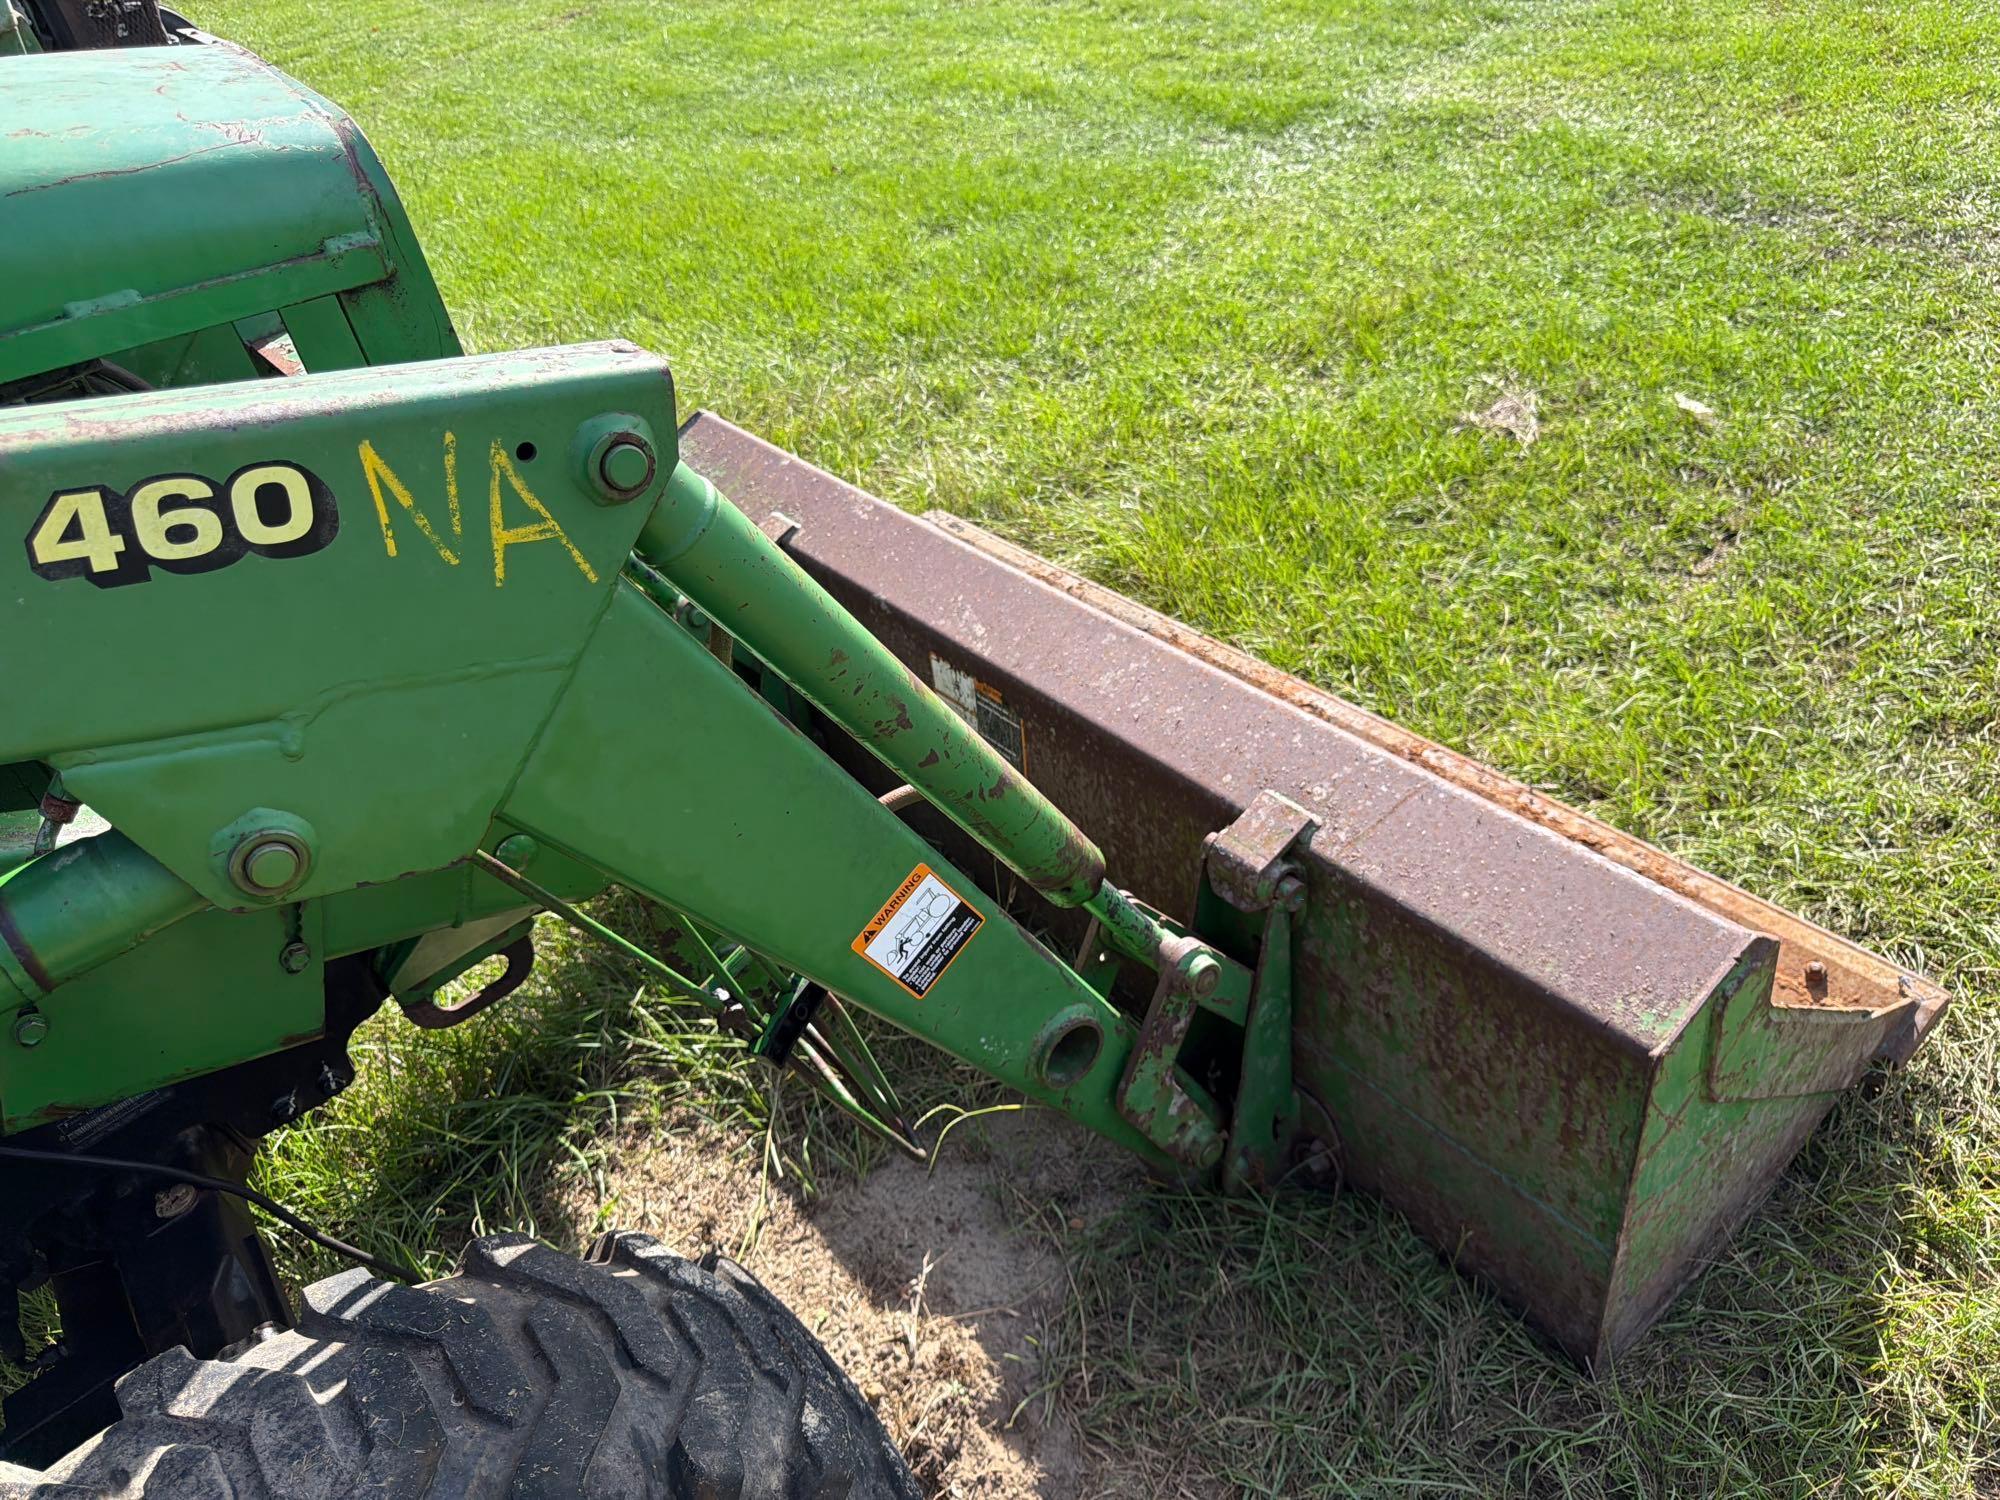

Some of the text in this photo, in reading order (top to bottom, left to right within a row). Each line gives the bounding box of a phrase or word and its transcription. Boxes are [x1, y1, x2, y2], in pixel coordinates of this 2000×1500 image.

[33, 466, 315, 573] 460
[359, 431, 598, 587] NA
[873, 872, 922, 927] WARNING
[907, 958, 921, 973] avoid
[919, 943, 934, 960] injury
[931, 931, 943, 944] from
